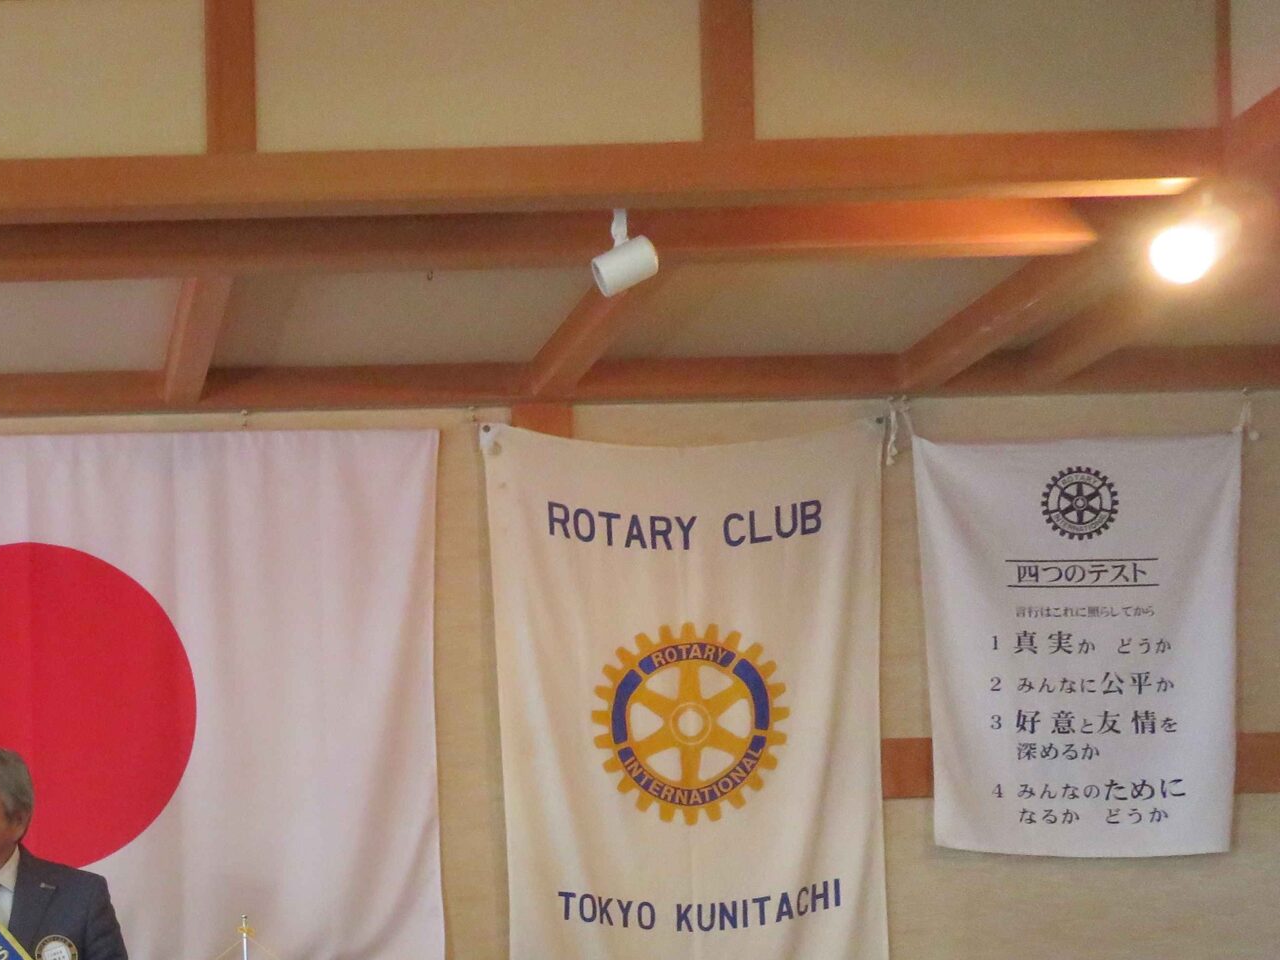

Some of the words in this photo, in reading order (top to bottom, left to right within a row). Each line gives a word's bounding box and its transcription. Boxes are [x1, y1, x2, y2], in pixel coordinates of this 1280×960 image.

[547, 501, 698, 550] ROTARY
[723, 499, 822, 547] CLUB
[1017, 563, 1147, 583] 四つのテスト
[991, 635, 998, 650] 1
[1014, 631, 1095, 654] 真実か
[1117, 638, 1171, 654] どうか
[651, 644, 726, 668] ROTARY
[990, 676, 1002, 692] 2
[1017, 671, 1175, 695] みんなに公平か
[990, 715, 1002, 730] 3
[1015, 710, 1178, 735] 好意と友情を
[1017, 743, 1100, 760] 深めるか
[624, 749, 762, 805] INTERNATIONAL
[991, 783, 1003, 798] 4
[1017, 778, 1186, 800] みんなのために
[1019, 808, 1080, 824] なるか
[1106, 807, 1169, 824] どうか
[558, 891, 656, 930] TOKYO
[676, 878, 841, 932] KUNITACHI
